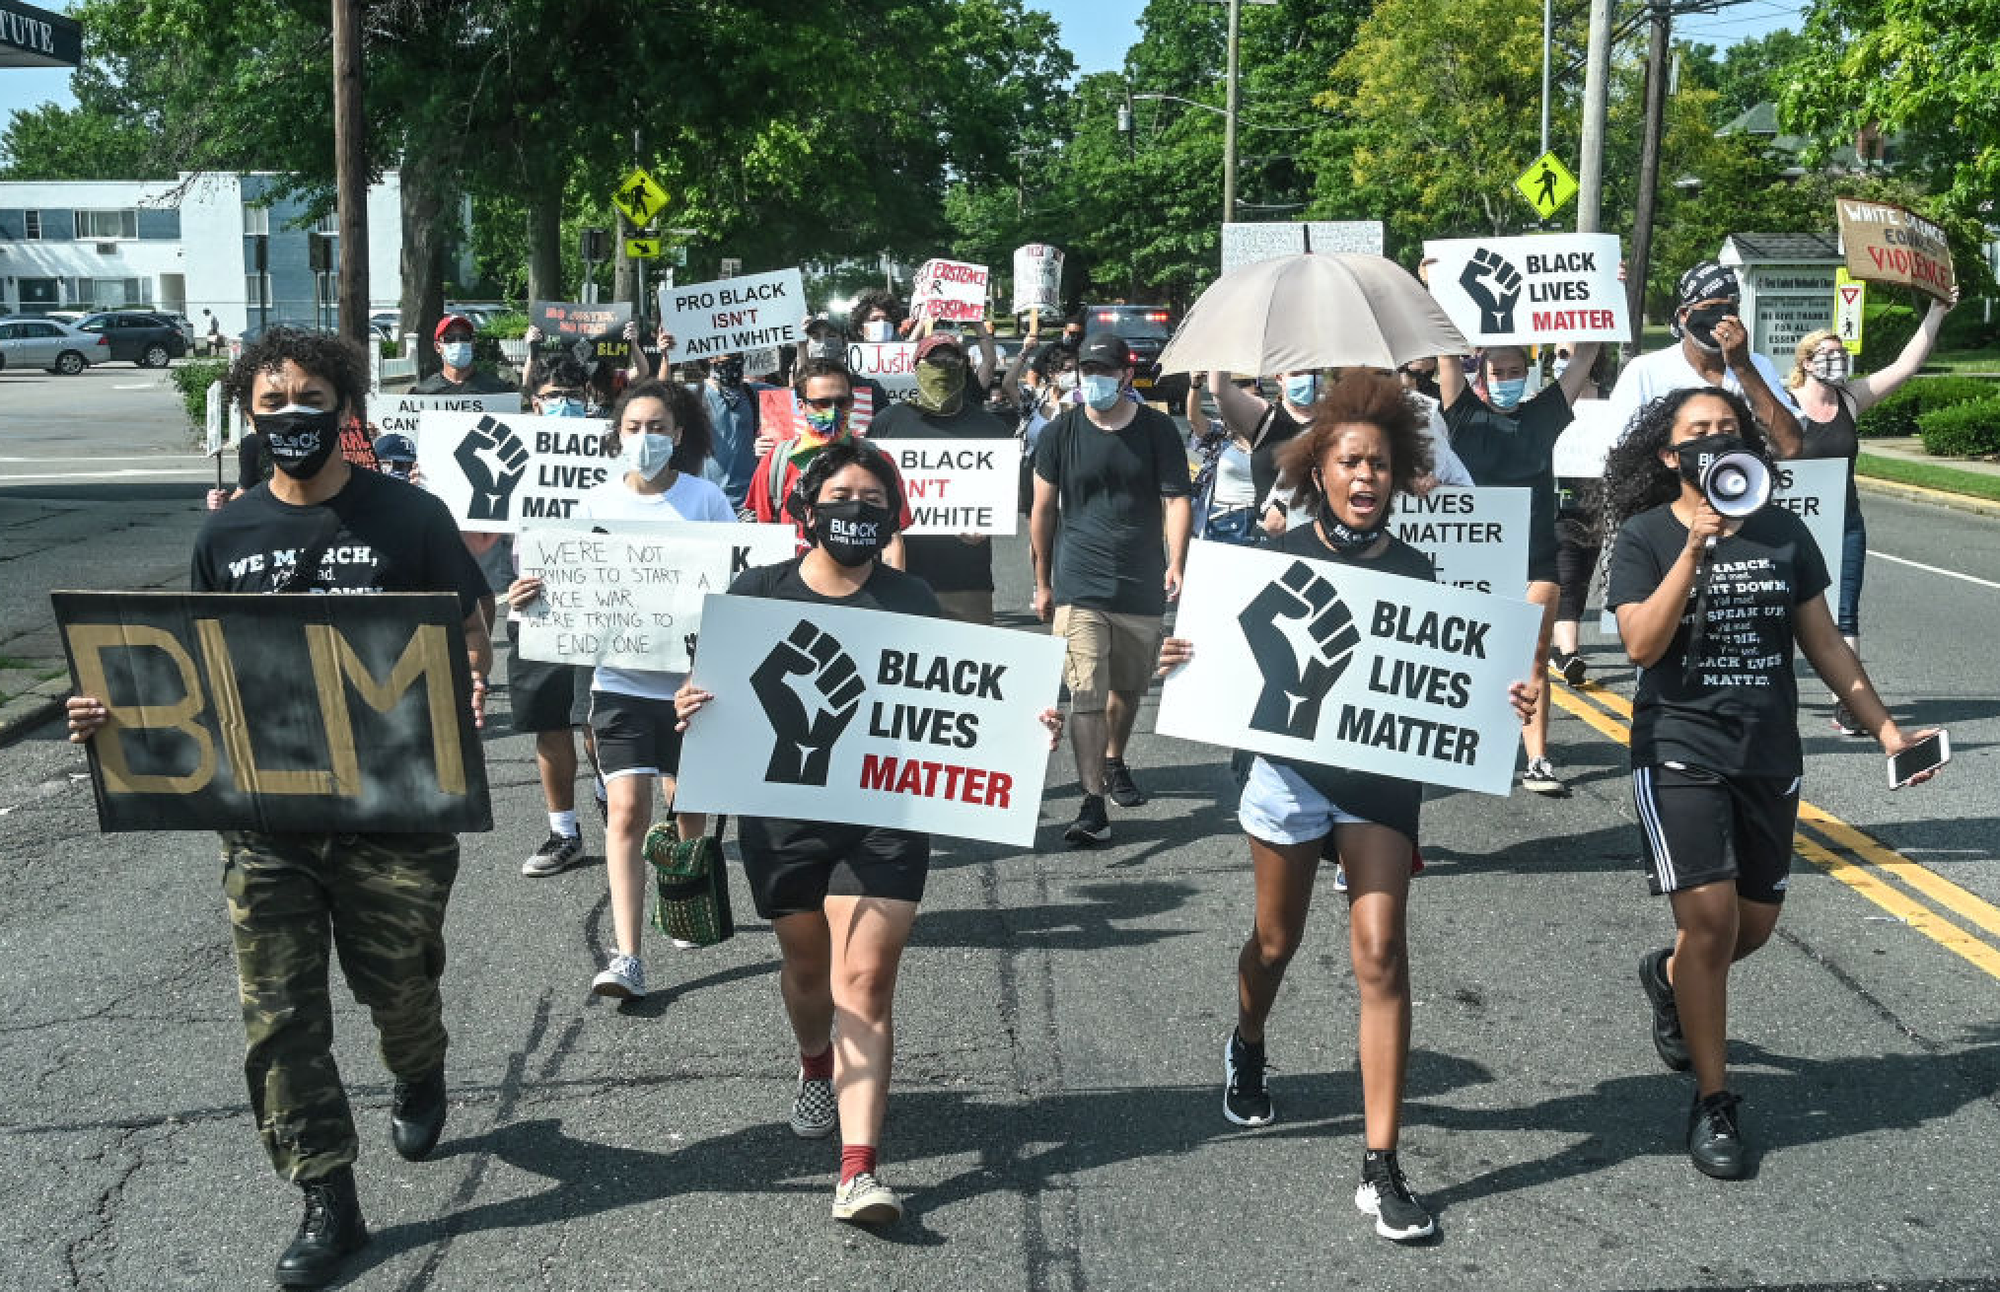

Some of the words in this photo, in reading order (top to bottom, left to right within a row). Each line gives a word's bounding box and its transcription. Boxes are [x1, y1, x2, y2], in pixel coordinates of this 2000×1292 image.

[0, 10, 54, 54] TUTE
[1843, 203, 1900, 226] WHITE
[1526, 252, 1597, 275] BLACK
[675, 293, 715, 313] PRO
[719, 281, 786, 307] BLACK
[1529, 281, 1591, 303] LIVES
[711, 309, 758, 329] ISN'T
[1532, 310, 1616, 332] MATTER
[1774, 323, 1792, 332] FOR
[597, 342, 628, 356] BLM
[686, 334, 728, 356] ANTI
[731, 325, 795, 348] WHITE
[1768, 334, 1804, 344] ESSENT
[849, 344, 863, 374] O
[434, 400, 484, 412] LIVES
[382, 417, 419, 431] CAN'
[900, 449, 995, 470] BLACK
[539, 464, 608, 490] LIVES
[909, 478, 951, 499] N'T
[522, 496, 580, 519] MAT
[1402, 494, 1475, 514] LIVES
[1772, 497, 1820, 517] TER
[914, 506, 993, 527] WHITE
[1400, 523, 1502, 543] MATTER
[229, 553, 265, 578] WE
[272, 545, 378, 567] MRCH,
[627, 545, 665, 563] NOT
[596, 567, 621, 583] TO
[630, 567, 681, 585] START
[698, 571, 711, 590] A
[1735, 580, 1790, 595] DOWN,
[583, 611, 644, 629] TRYING
[652, 612, 675, 628] TO
[1707, 607, 1759, 622] SPEAK
[1370, 600, 1492, 660] BLACK
[557, 634, 600, 655] END
[612, 633, 650, 655] ONE
[877, 648, 1008, 701] BLACK
[1368, 654, 1472, 709] LIVES
[66, 618, 467, 796] BLM
[869, 701, 979, 749] LIVES
[1336, 703, 1480, 767] MATTER
[860, 753, 1013, 809] MATTER
